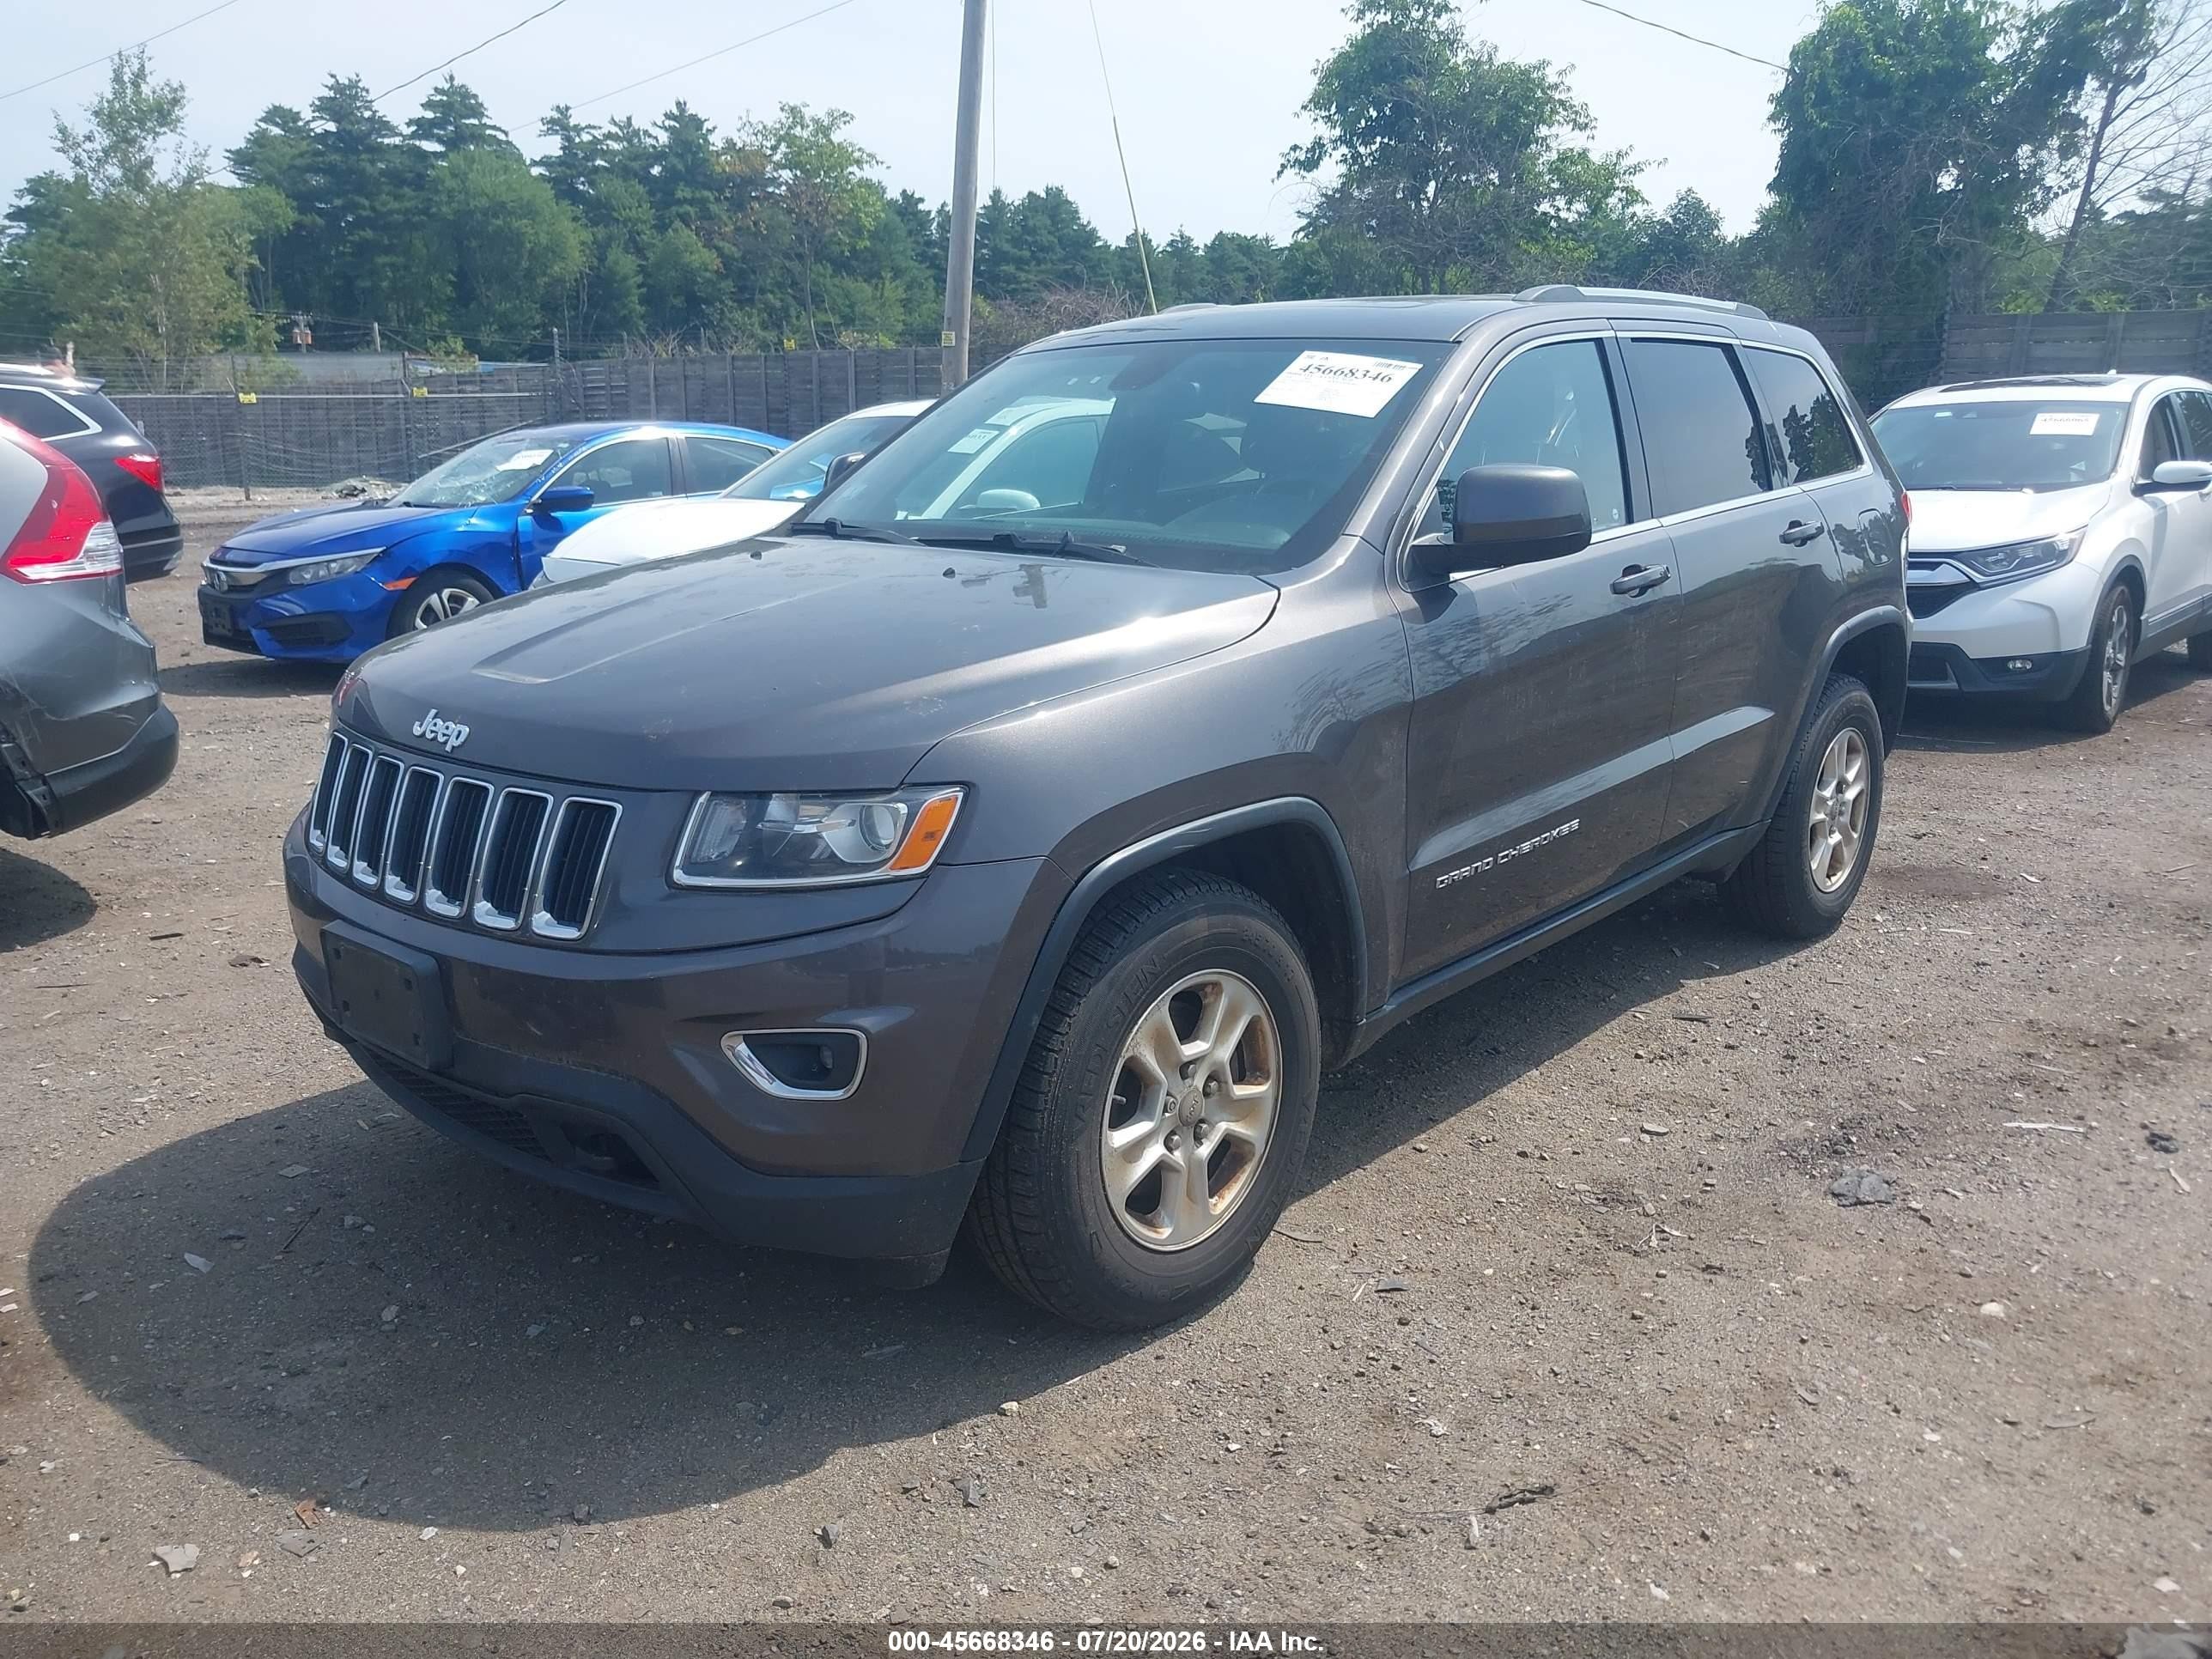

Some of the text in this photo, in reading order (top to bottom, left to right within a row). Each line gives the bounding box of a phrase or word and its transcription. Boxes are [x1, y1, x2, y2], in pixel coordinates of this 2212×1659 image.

[1298, 362, 1395, 384] 45668346
[412, 708, 470, 753] Jeep
[1436, 817, 1581, 889] GRAND CHEROKEE
